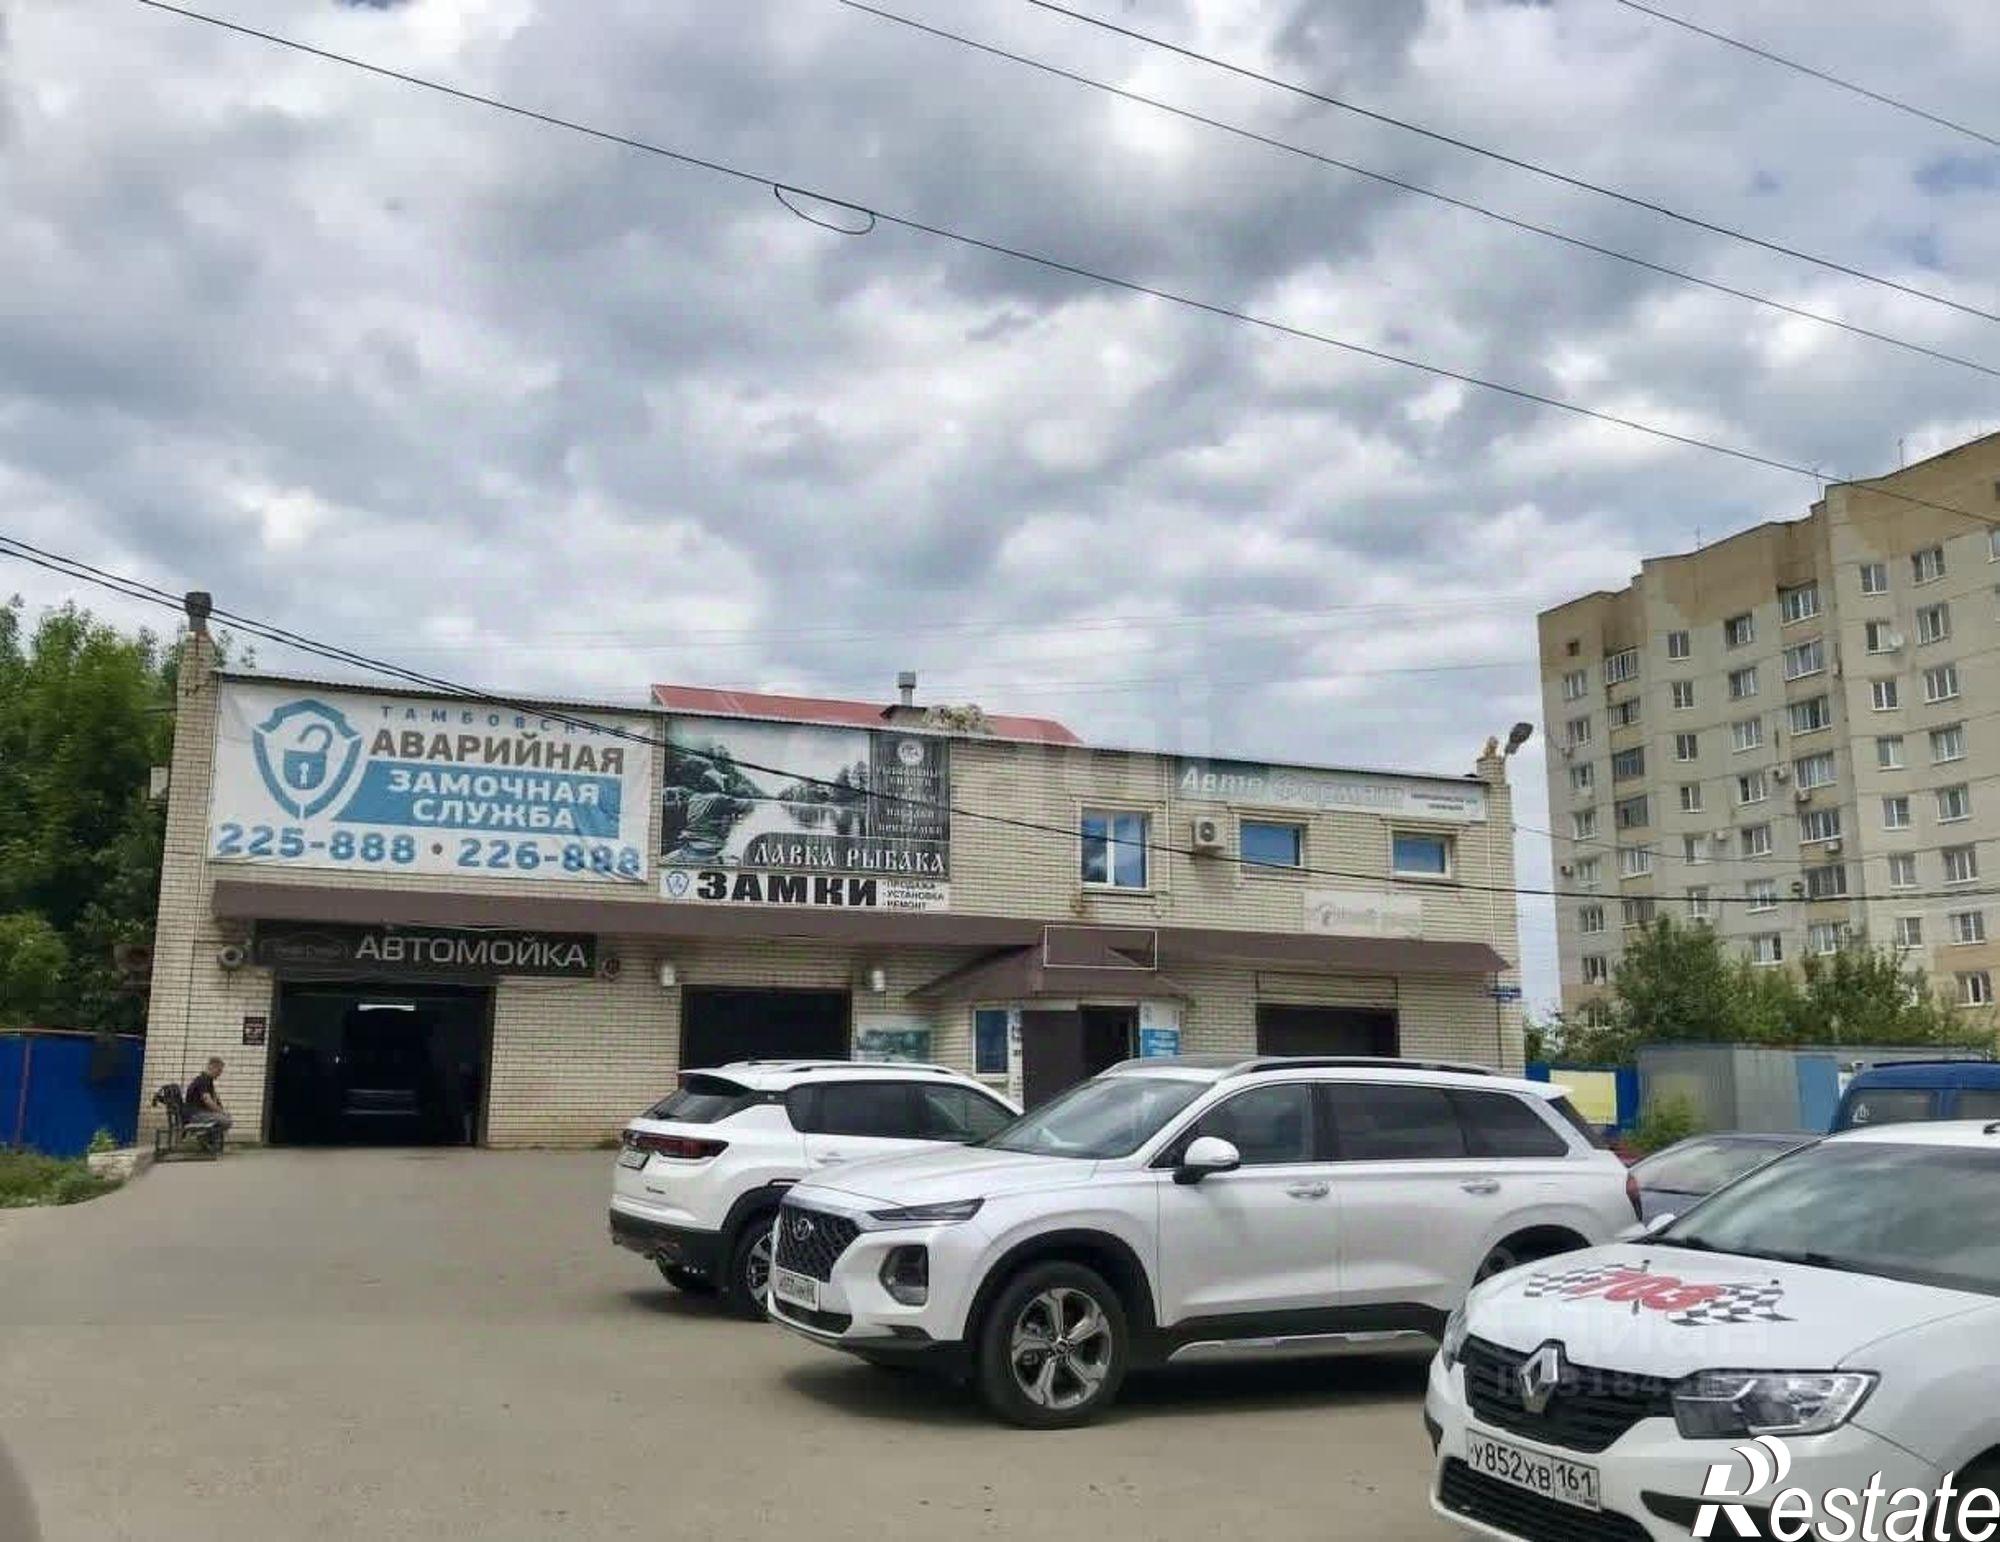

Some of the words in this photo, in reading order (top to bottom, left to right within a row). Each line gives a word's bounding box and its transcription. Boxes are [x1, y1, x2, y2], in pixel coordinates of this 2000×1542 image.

[380, 705, 627, 737] ТАМБОВСК
[370, 729, 625, 775] АВАРИЙНАЯ
[387, 769, 600, 805] ЗАМОЧНАЯ
[412, 799, 576, 830] СЛУЖБА
[216, 822, 416, 865] 225-888
[458, 838, 641, 875] 226-888
[754, 842, 836, 867] ЛАВКА
[846, 848, 946, 872] РЫБАКА
[697, 873, 877, 906] ЗАМКИ
[354, 934, 588, 970] АВТОМОЙКА
